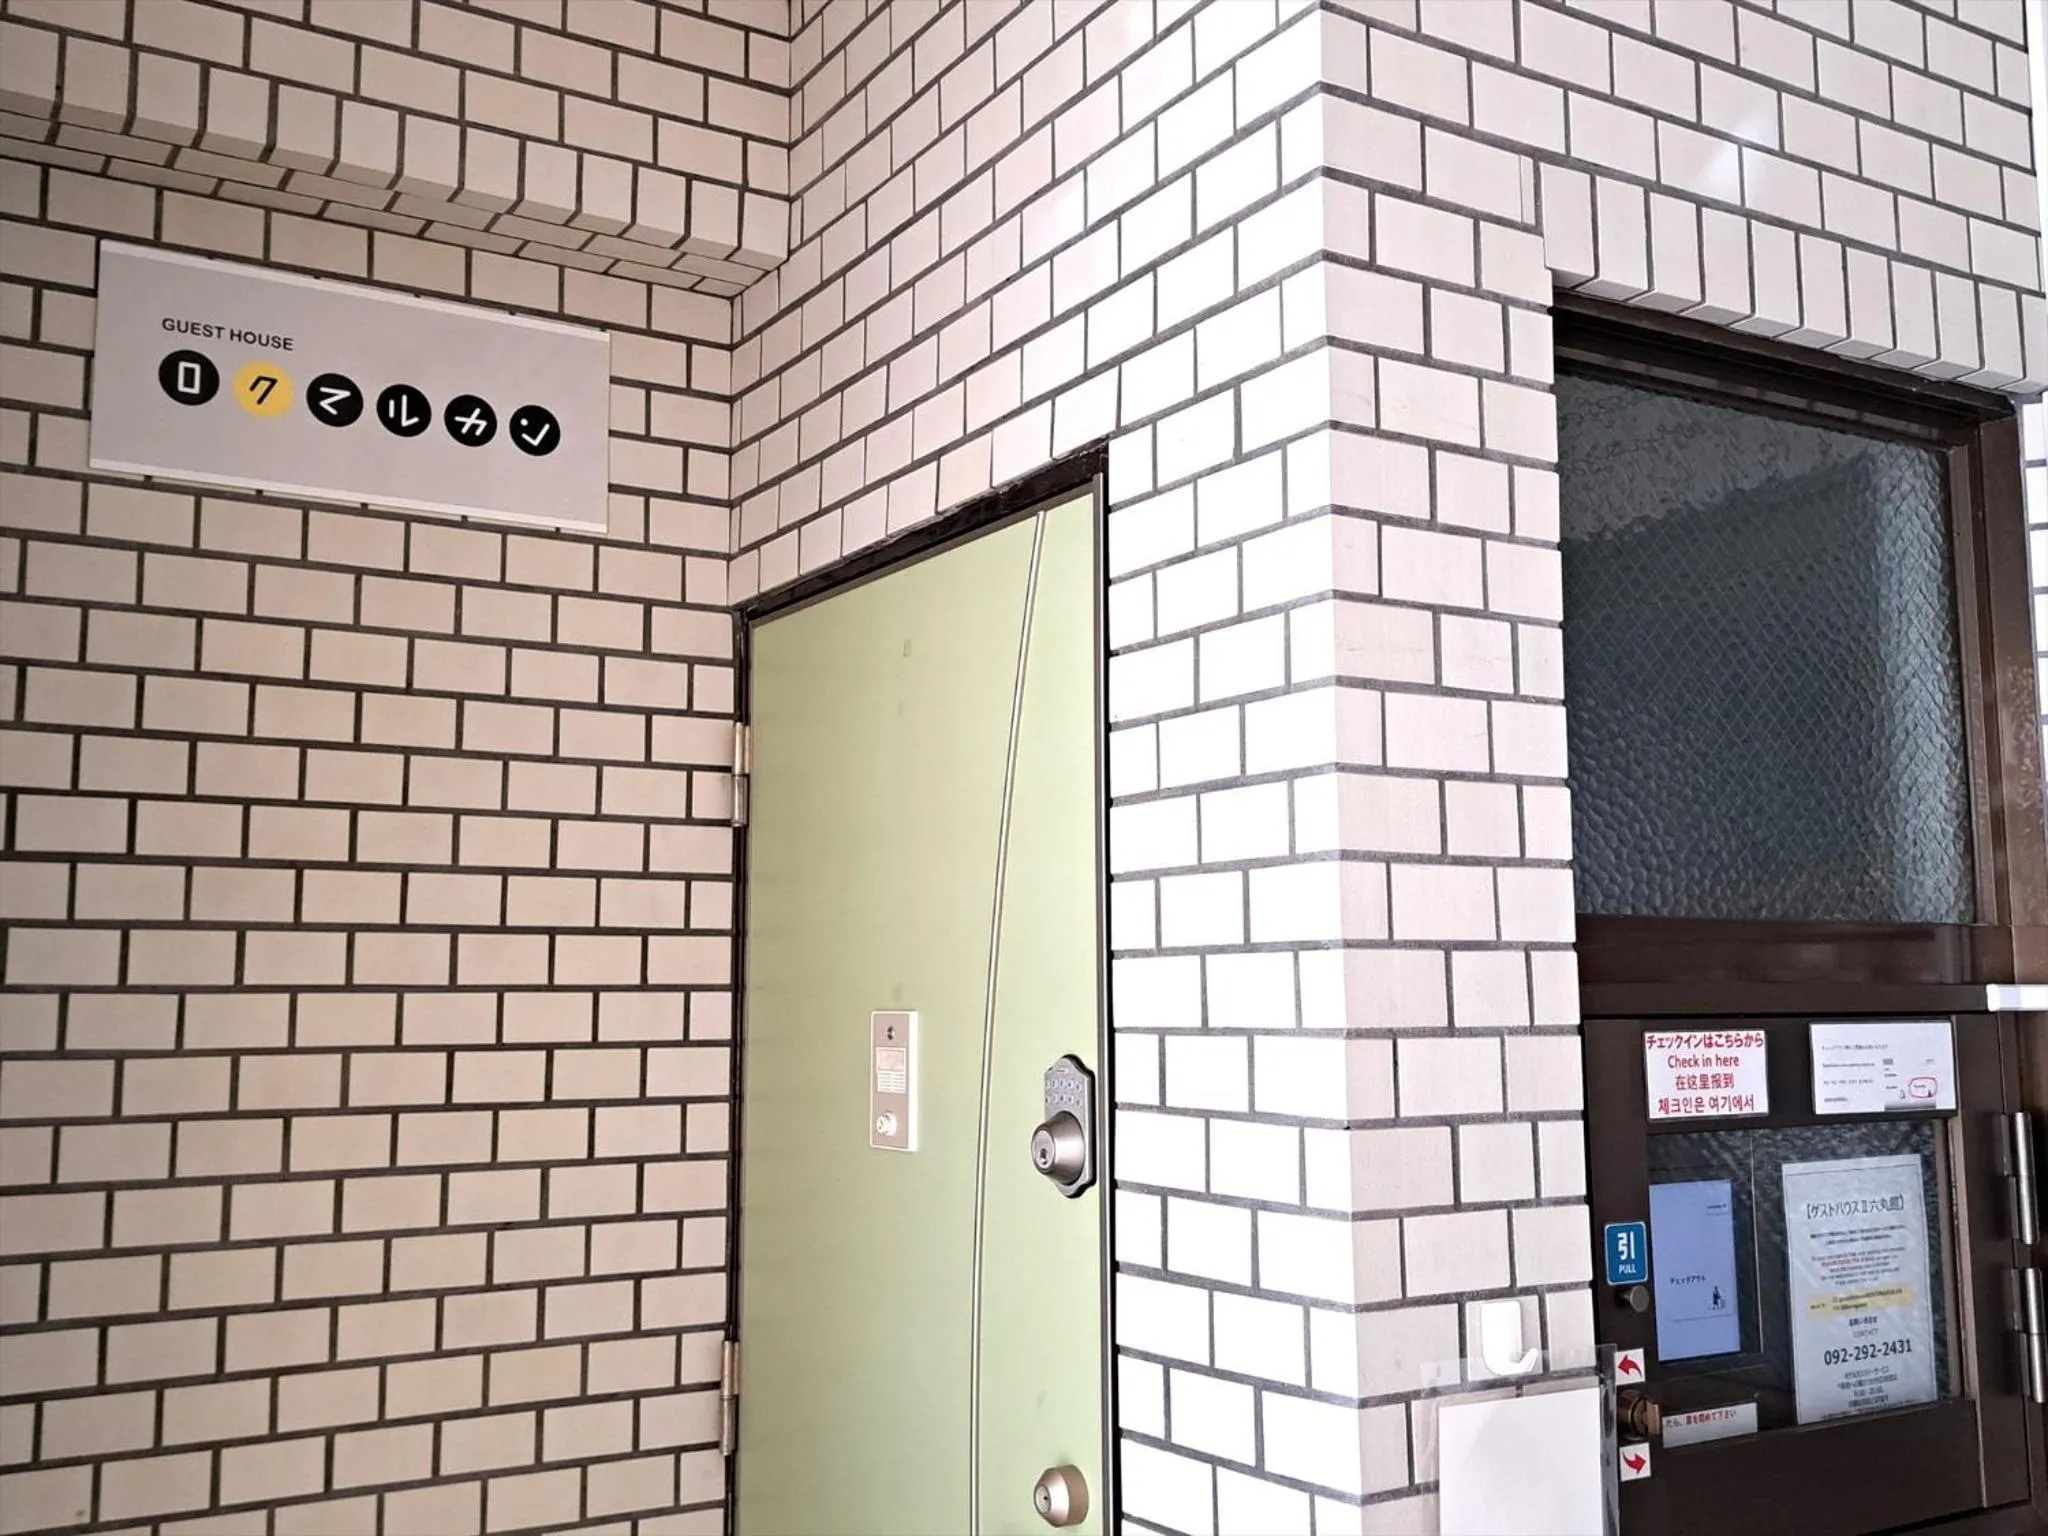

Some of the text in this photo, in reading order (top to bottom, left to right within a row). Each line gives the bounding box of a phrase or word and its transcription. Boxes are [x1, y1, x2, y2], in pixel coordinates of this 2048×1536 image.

[161, 316, 295, 351] GUEST HOUSE
[1646, 1033, 1764, 1049] チェックインはこちらから
[1667, 1053, 1740, 1069] Check in here
[1675, 1072, 1735, 1091] 在这里报到
[1658, 1094, 1755, 1115] 체크인은 여기에서
[1617, 1230, 1636, 1261] 引
[1618, 1264, 1637, 1275] PULL
[1823, 1338, 1913, 1366] 092-292-2431
